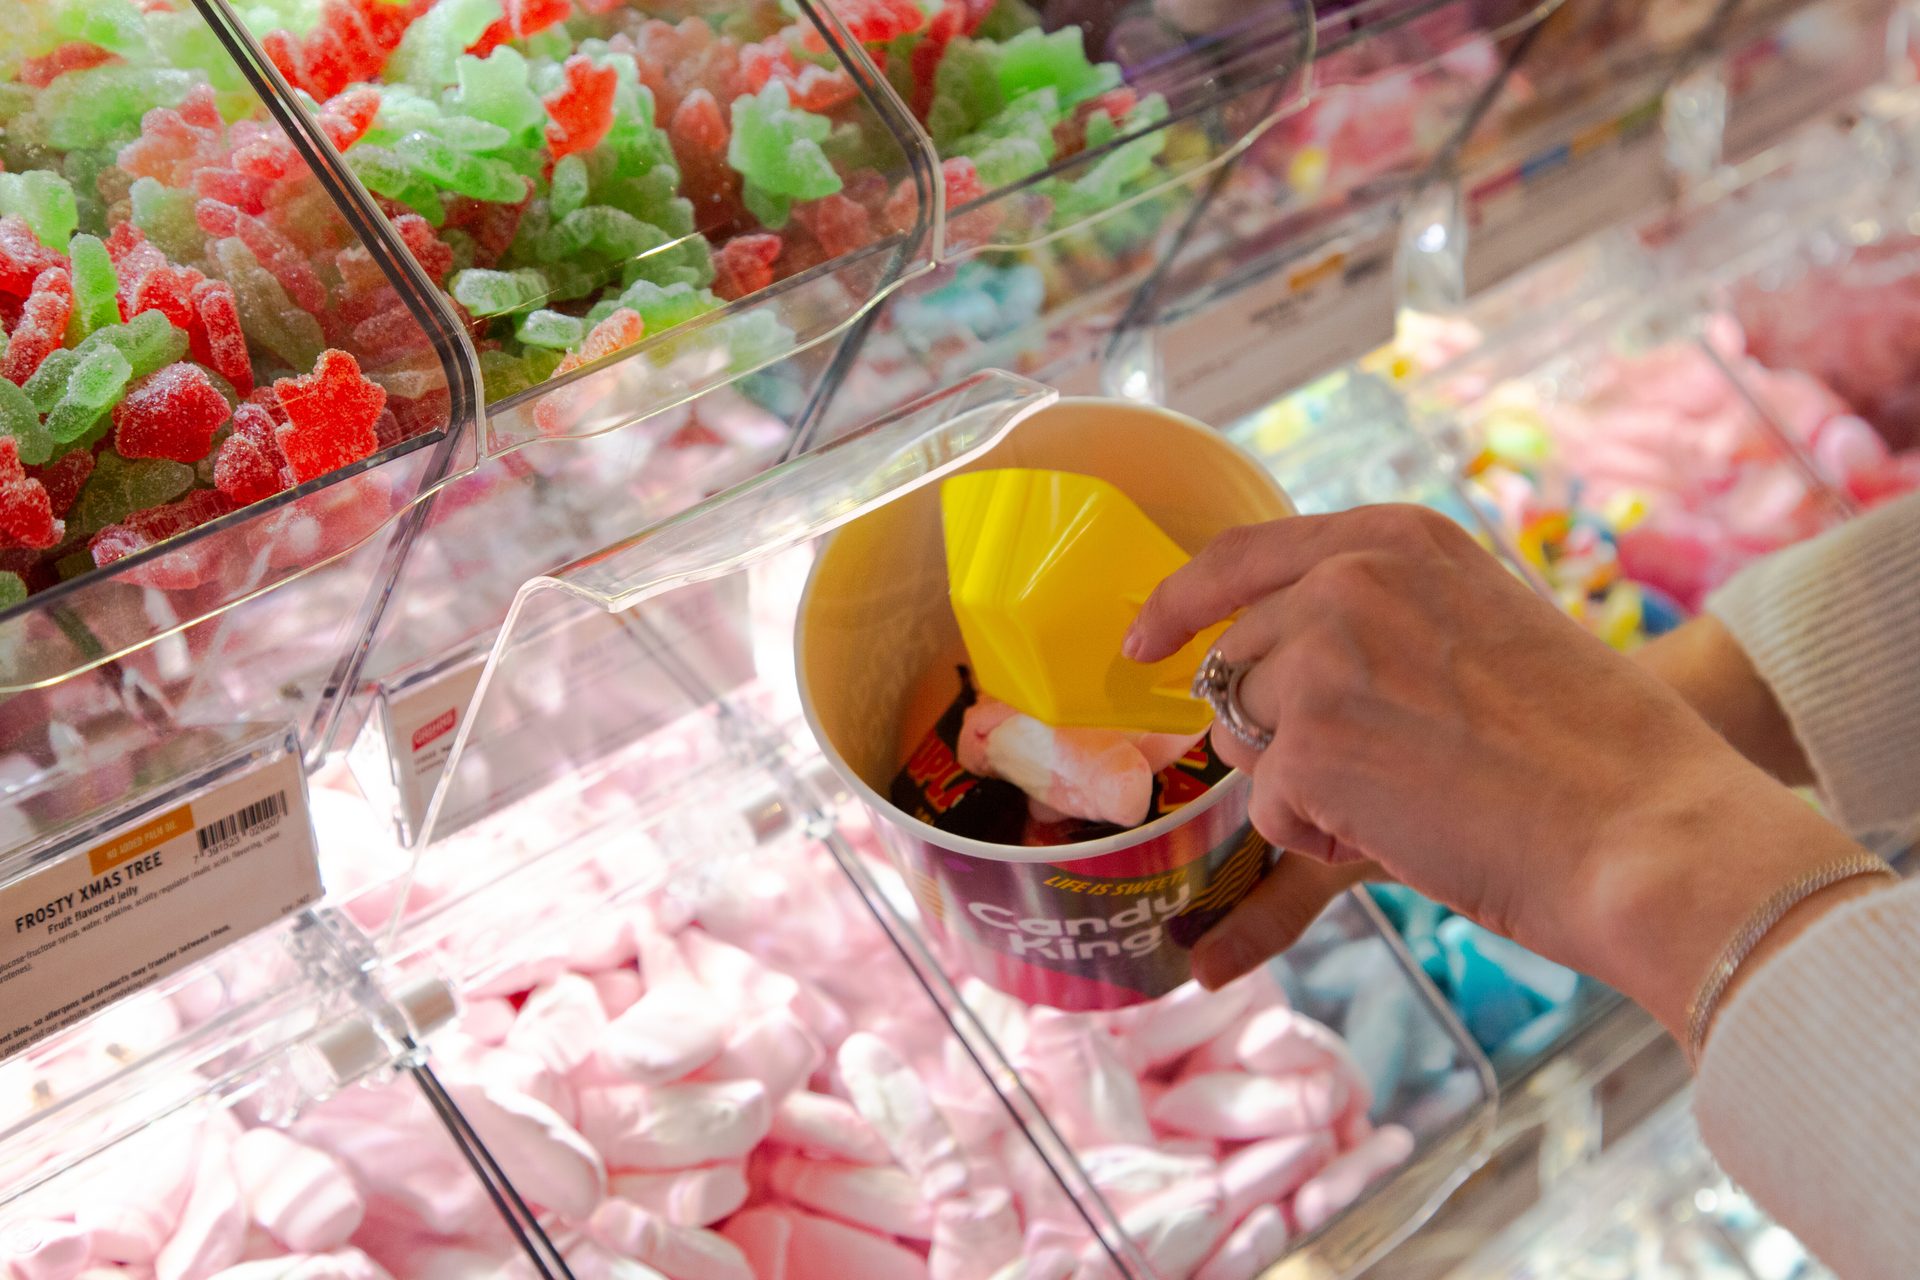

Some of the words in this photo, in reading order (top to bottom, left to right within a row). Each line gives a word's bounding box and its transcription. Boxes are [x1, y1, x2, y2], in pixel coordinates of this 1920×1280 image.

[15, 892, 75, 933] FROSTY
[79, 871, 122, 903] XMAS
[125, 851, 163, 880] TREE
[47, 916, 74, 935] Fruit
[75, 895, 116, 922] flavored
[117, 885, 139, 903] jelly
[159, 876, 190, 894] regulator
[968, 883, 1190, 936] Candy
[1043, 875, 1091, 893] LIFE
[1088, 883, 1114, 896] IS
[1008, 924, 1163, 960] King
[44, 999, 80, 1021] allergens
[96, 975, 130, 997] products
[148, 951, 178, 969] transfer
